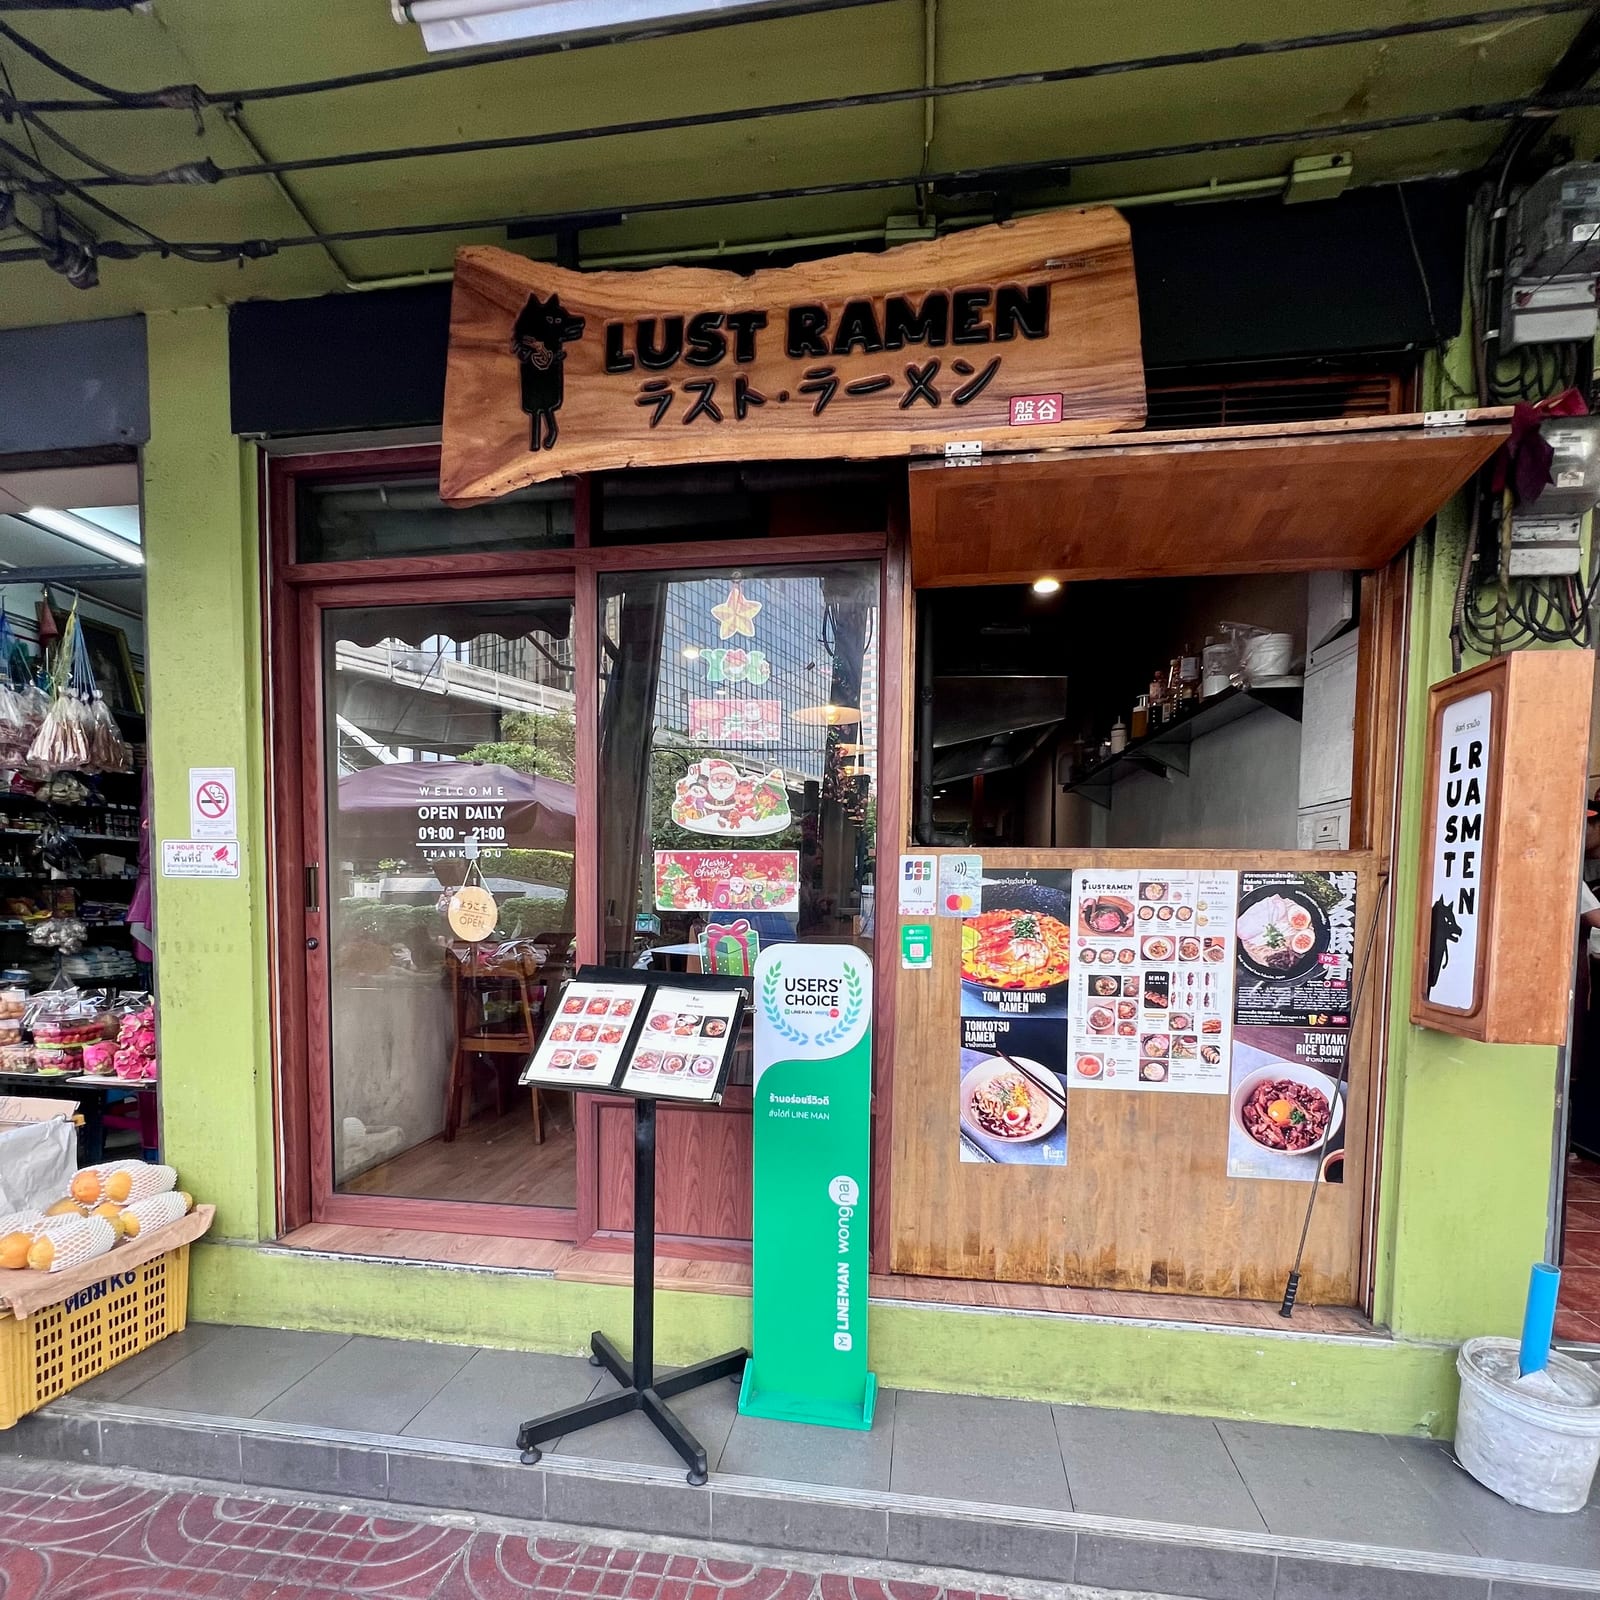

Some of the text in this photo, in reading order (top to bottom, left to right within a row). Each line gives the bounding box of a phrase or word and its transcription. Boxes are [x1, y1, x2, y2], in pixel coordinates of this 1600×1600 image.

[604, 283, 1051, 374] LUST RAMEN
[634, 355, 1002, 428] ラスト・ラーメン
[1014, 398, 1057, 422] 盤谷
[419, 786, 504, 796] WELCOME
[418, 806, 505, 820] OPEN DAILY
[1444, 745, 1462, 878] LUST
[418, 827, 454, 840] 09:00
[471, 826, 505, 840] 21:00
[1458, 740, 1482, 915] RAMEN
[422, 849, 502, 858] THANK YOU
[459, 915, 486, 928] OPEN
[784, 978, 843, 993] USERS'
[784, 994, 839, 1007] CHOICE
[982, 991, 1046, 1004] TOM YUM KUNG
[998, 1002, 1029, 1013] RAMEN
[965, 1020, 1010, 1032] TONKOTSU
[965, 1031, 995, 1042] RAMEN
[1303, 1033, 1347, 1045] TERIYAKI
[1296, 1044, 1317, 1056] RICE
[791, 1111, 809, 1119] LINE
[810, 1112, 830, 1121] MAN
[835, 1178, 854, 1254] wongnai
